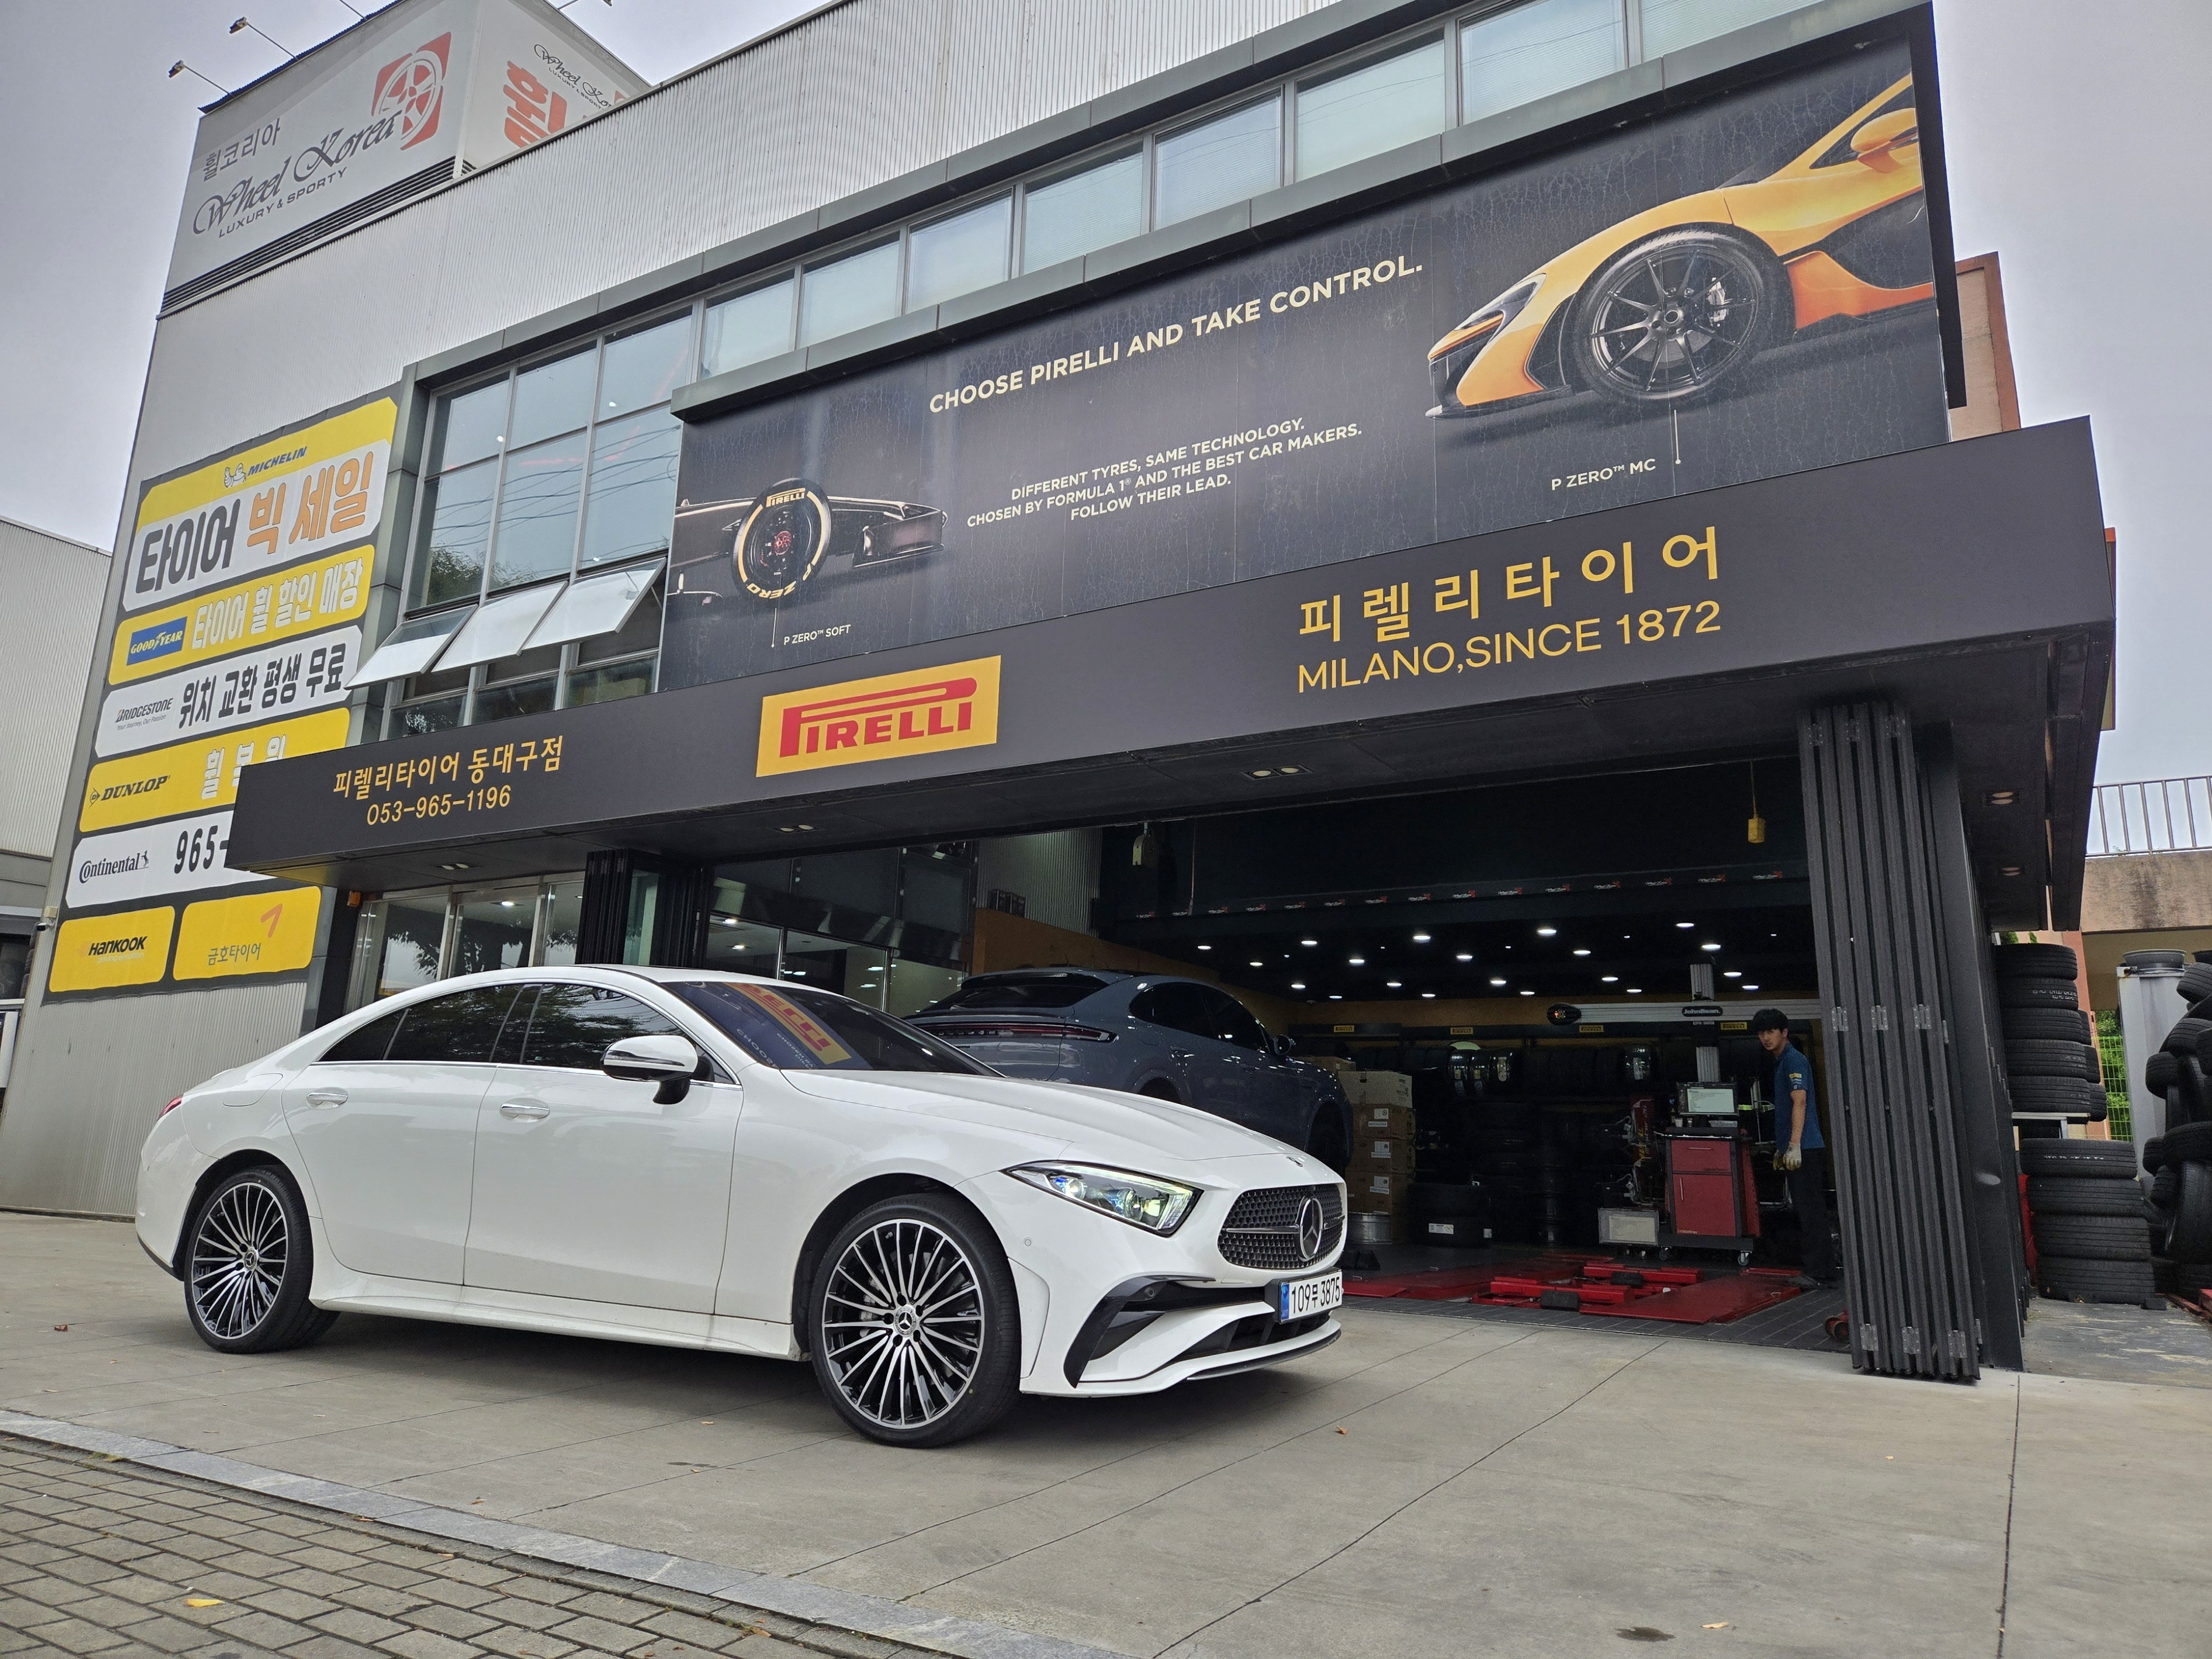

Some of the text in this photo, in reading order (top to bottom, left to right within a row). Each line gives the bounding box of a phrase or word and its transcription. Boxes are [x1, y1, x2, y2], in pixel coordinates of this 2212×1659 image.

[534, 44, 581, 85] Wheel
[582, 82, 612, 108] Kor
[193, 110, 402, 234] Wheel Korea
[203, 117, 281, 182] 휠코리아
[219, 167, 347, 238] LUXURY & SPORTY
[930, 255, 1422, 414] CHOOSE PIRELLI AND TAKE CONTROL.
[248, 446, 308, 476] MICHELIN
[967, 505, 1022, 528] CHOSEN
[1025, 500, 1043, 514] BY
[1047, 484, 1116, 505] FORMULA
[1135, 471, 1168, 488] AND
[1172, 462, 1202, 479] THE
[1205, 452, 1245, 472] BEST
[1249, 442, 1282, 461] CAR
[1287, 423, 1363, 453] MAKERS.
[1011, 418, 1305, 500] DIFFERENT TYRES, SAME TECHNOLOGY.
[1551, 478, 1562, 491] P
[1630, 458, 1656, 473] MC
[766, 488, 806, 507] PIRELLI
[1070, 474, 1232, 520] FOLLOW THEIR LEAD.
[135, 451, 374, 593] 타이어 빅 세일
[192, 556, 364, 649] 타이어 휠 할인 매장
[747, 581, 796, 598] ZERO
[131, 629, 183, 654] GOODYEAR
[784, 636, 790, 645] P
[826, 624, 851, 637] SOFT
[1616, 600, 1721, 644] 1872
[179, 642, 347, 729] 위치 교환 평생 무료
[115, 697, 174, 723] BRIDGESTONE
[779, 677, 977, 758] PIRELLI
[101, 775, 168, 802] DUNLOP
[201, 747, 225, 800] 휠
[333, 735, 563, 800] 피렐리타이어 동대구점
[367, 784, 512, 825] 053-965-1196
[79, 852, 140, 884] Continental
[208, 942, 262, 966] 금호타이어
[1292, 1277, 1340, 1313] 109무 3875
